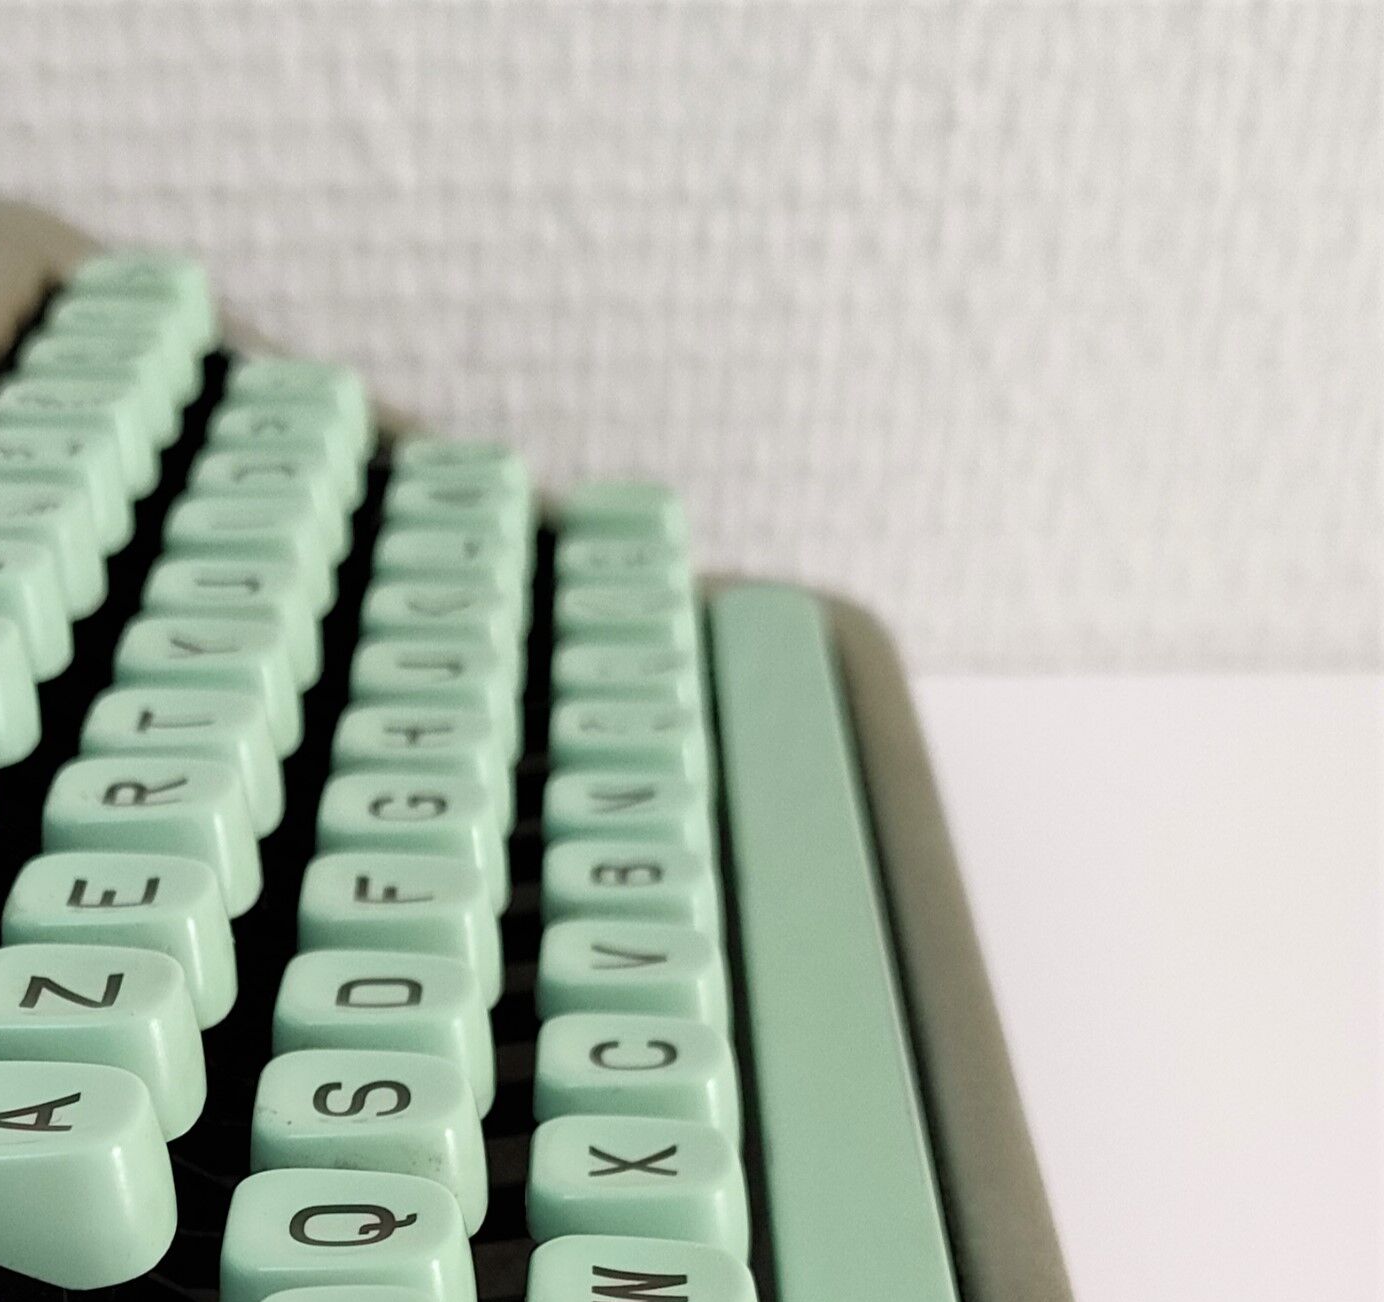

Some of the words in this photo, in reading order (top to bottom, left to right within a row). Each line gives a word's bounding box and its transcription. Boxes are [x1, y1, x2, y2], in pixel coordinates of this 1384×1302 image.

[136, 708, 216, 734] T
[101, 775, 190, 808] R
[369, 790, 449, 823] G
[589, 858, 665, 888] B
[67, 877, 160, 909] E
[353, 875, 434, 905] F
[590, 941, 669, 970] V
[19, 973, 124, 1009] Z
[335, 977, 423, 1009] D
[589, 1040, 678, 1071] C
[312, 1080, 412, 1118] S
[588, 1144, 678, 1177] X
[289, 1204, 417, 1247] Q
